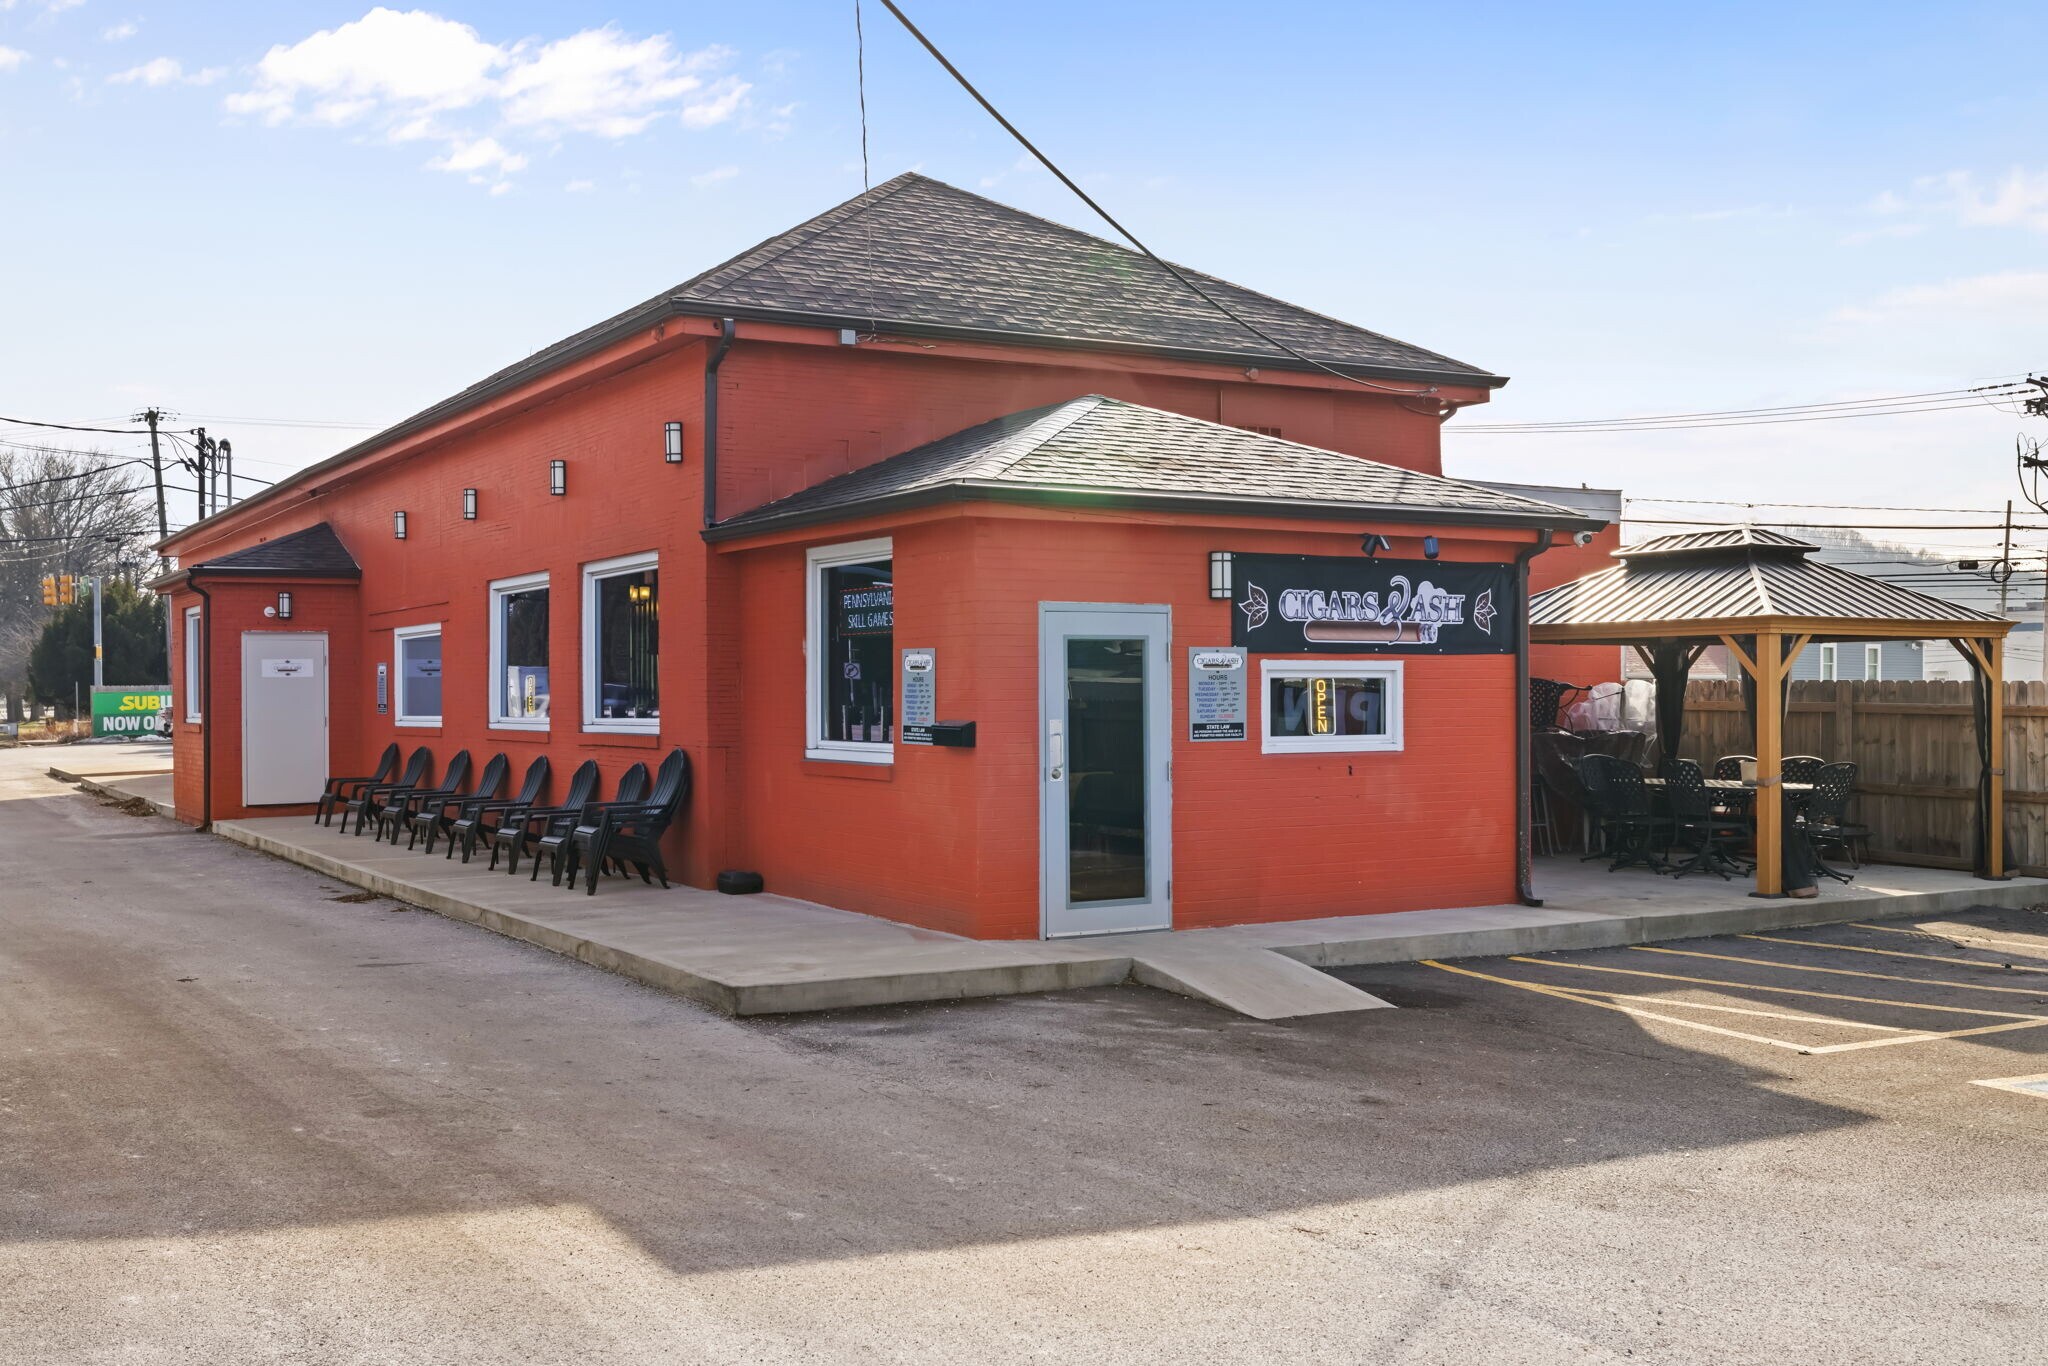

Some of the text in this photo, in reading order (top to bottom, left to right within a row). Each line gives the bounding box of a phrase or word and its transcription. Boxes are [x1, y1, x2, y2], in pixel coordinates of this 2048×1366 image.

[843, 590, 893, 609] PENNSYLVANI
[1280, 575, 1465, 625] CIGARS & ASH
[848, 611, 893, 629] SKILL GAMES
[1316, 679, 1328, 733] OPEN
[103, 716, 140, 731] NOW
